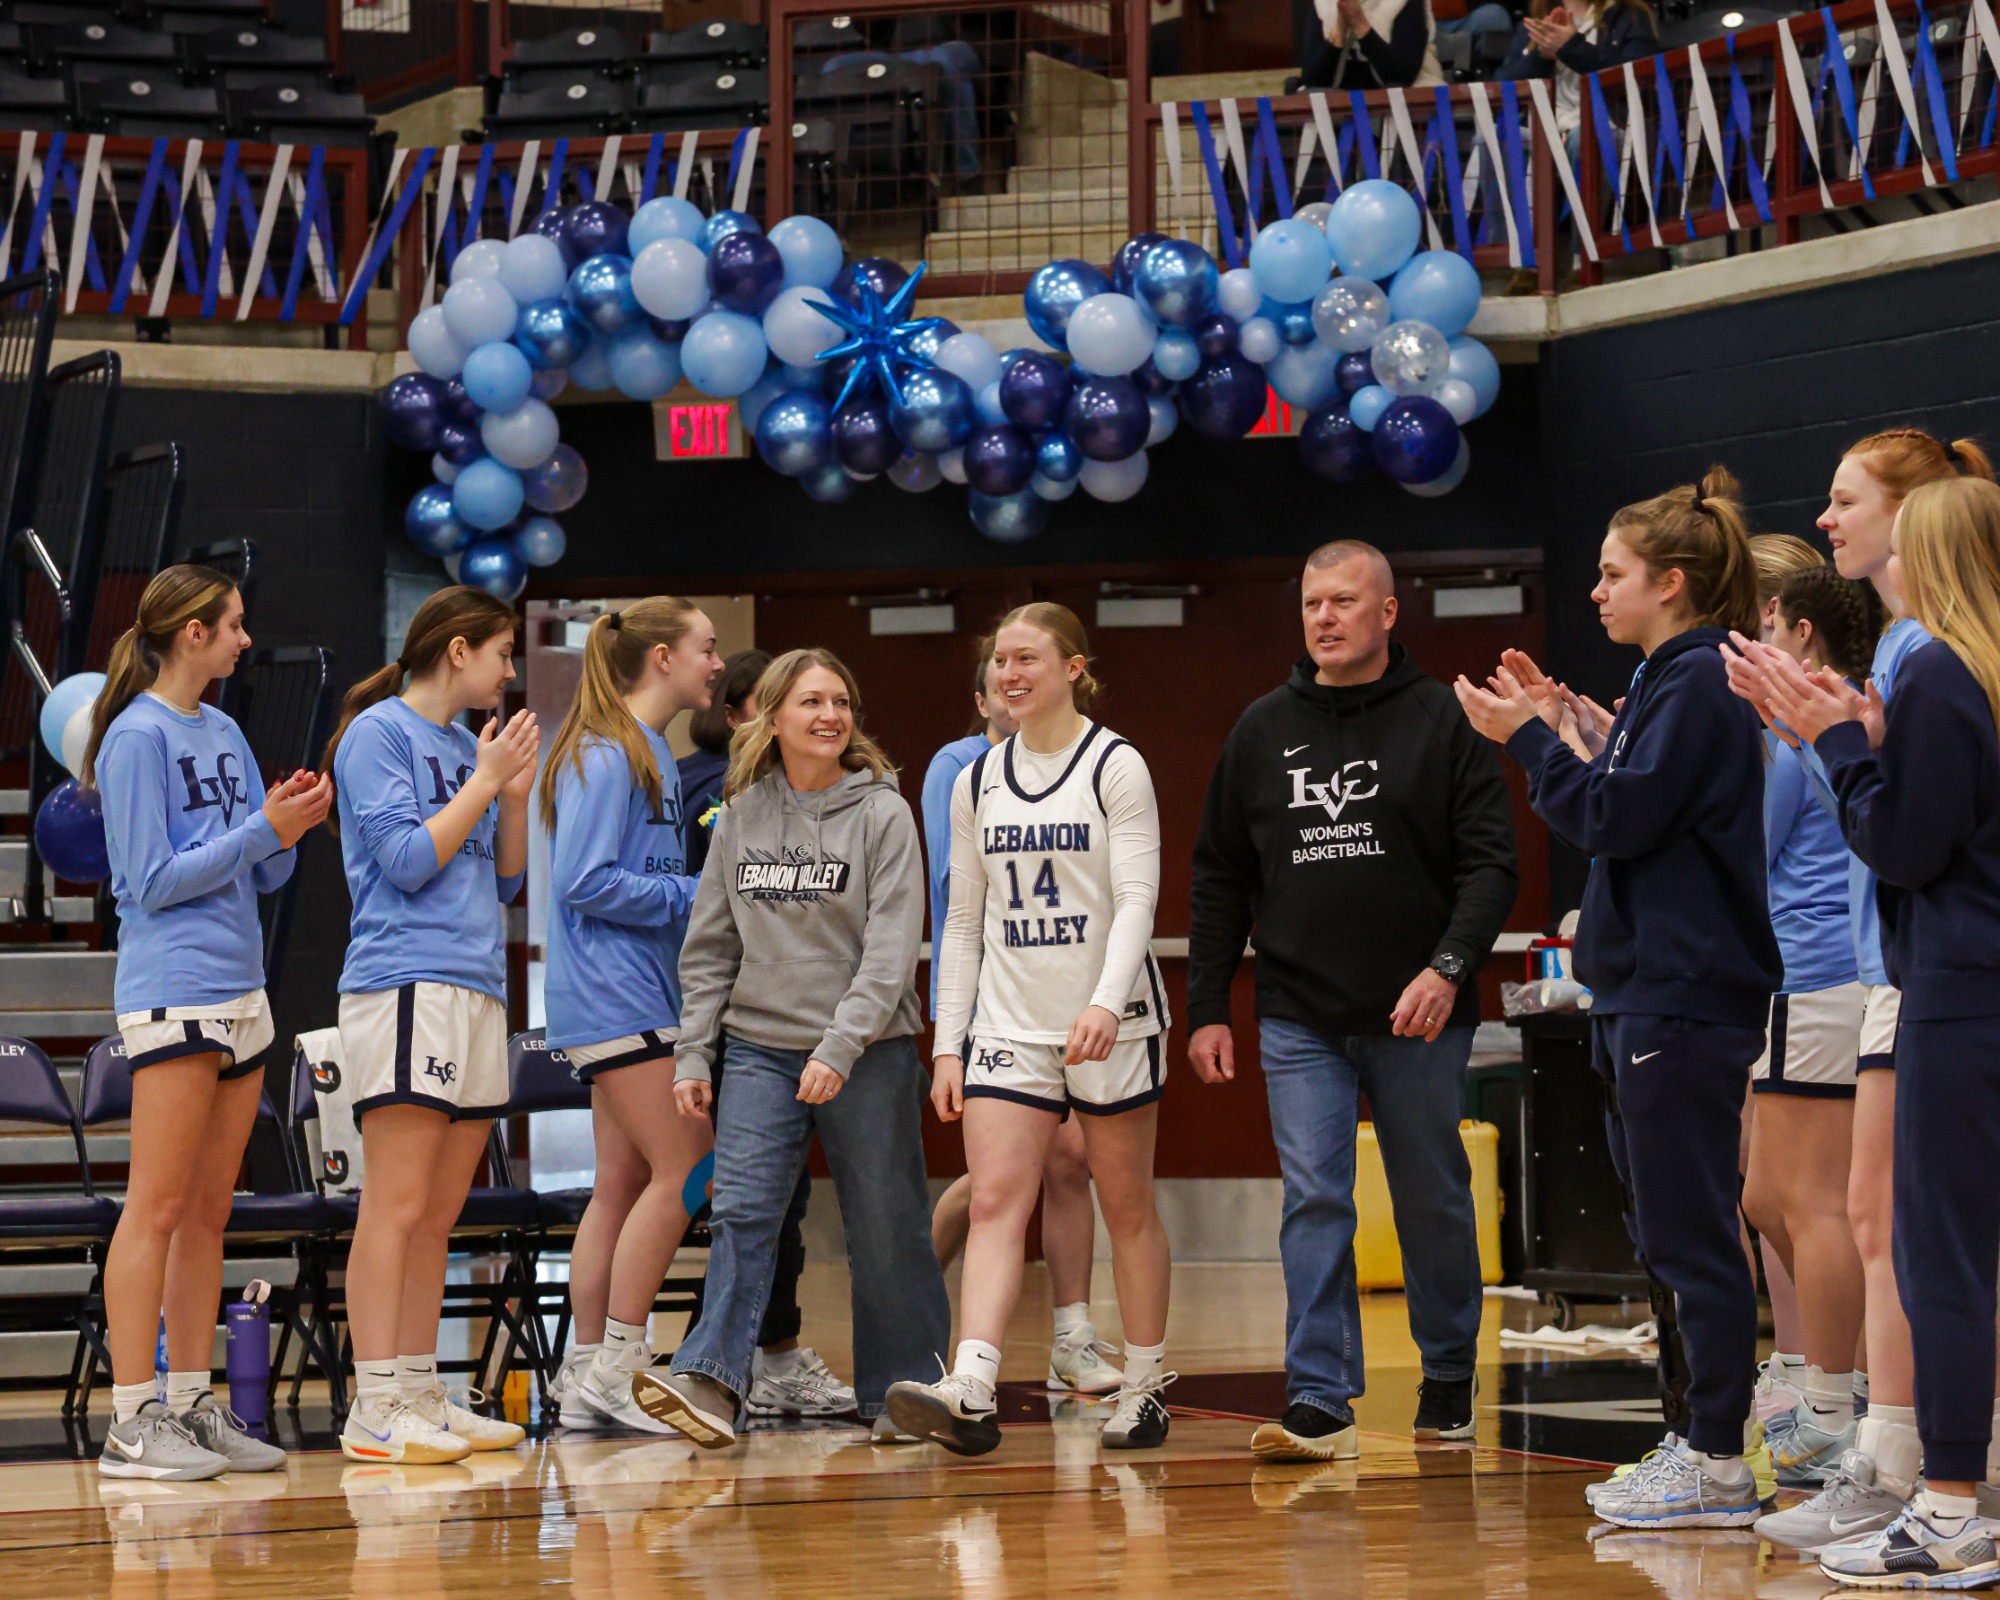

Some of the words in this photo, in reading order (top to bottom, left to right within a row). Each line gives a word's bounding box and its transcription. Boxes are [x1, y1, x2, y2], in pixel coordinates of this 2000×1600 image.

[669, 404, 731, 456] EXIT
[1286, 760, 1380, 822] LVC
[983, 823, 1090, 855] LEBANON
[1300, 822, 1374, 843] WOMEN'S
[1292, 840, 1386, 864] BASKETBALL
[738, 864, 799, 891] LEBANON
[796, 863, 844, 891] VALLEY
[1005, 858, 1061, 911] 14
[753, 891, 819, 902] BASKETBALL
[424, 1056, 457, 1086] LVC
[976, 1048, 1015, 1074] LVC
